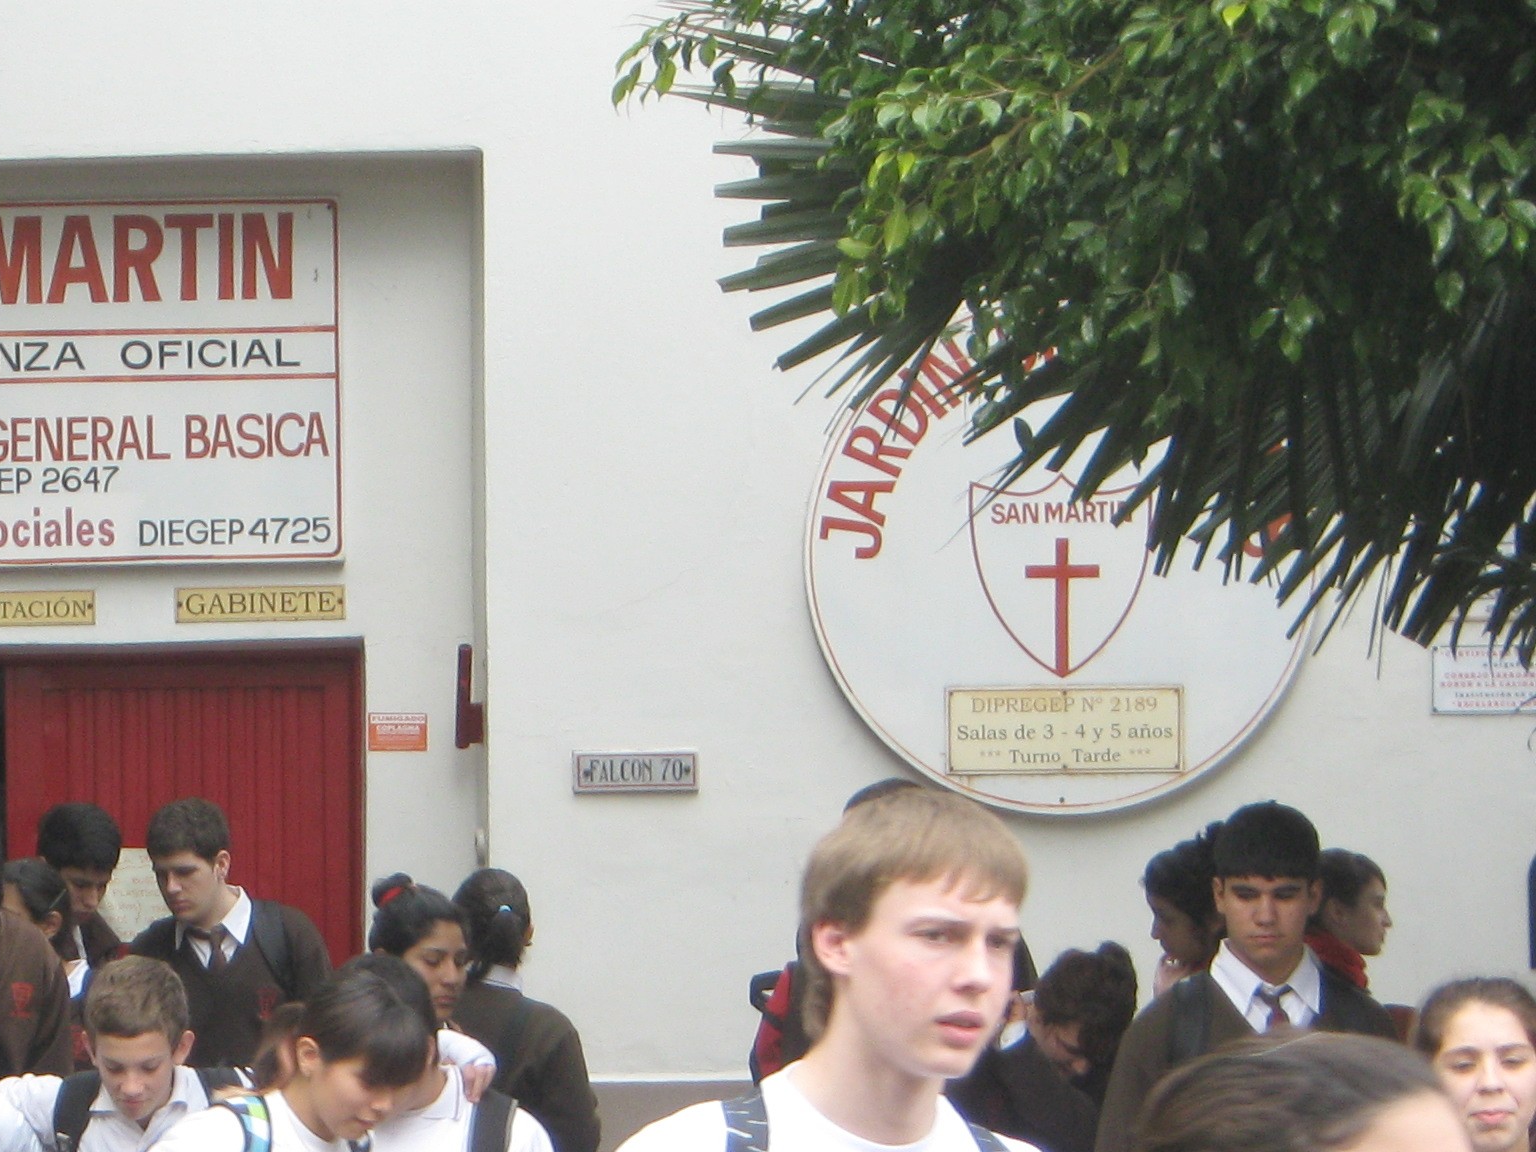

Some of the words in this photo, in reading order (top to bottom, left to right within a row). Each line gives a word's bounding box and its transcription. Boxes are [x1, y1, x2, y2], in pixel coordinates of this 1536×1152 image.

[119, 338, 301, 371] OFICIAL
[183, 411, 330, 461] BASICA
[40, 466, 120, 494] 2647
[990, 502, 1040, 525] SAN
[138, 518, 245, 548] DIEGEP
[246, 516, 332, 546] 4725
[184, 590, 337, 616] GABINETE
[971, 697, 1074, 713] DIPREGEP
[1110, 696, 1158, 712] 2189
[956, 724, 1008, 741] Salas
[1014, 724, 1036, 740] de
[1042, 723, 1055, 740] 3
[1074, 723, 1087, 739] 4
[1092, 728, 1104, 743] y
[1110, 723, 1122, 739] 5
[1127, 723, 1174, 739] años
[1009, 749, 1061, 763] Turno
[1071, 748, 1121, 763] Tarde
[588, 758, 652, 782] FALCON
[661, 758, 684, 782] 70
